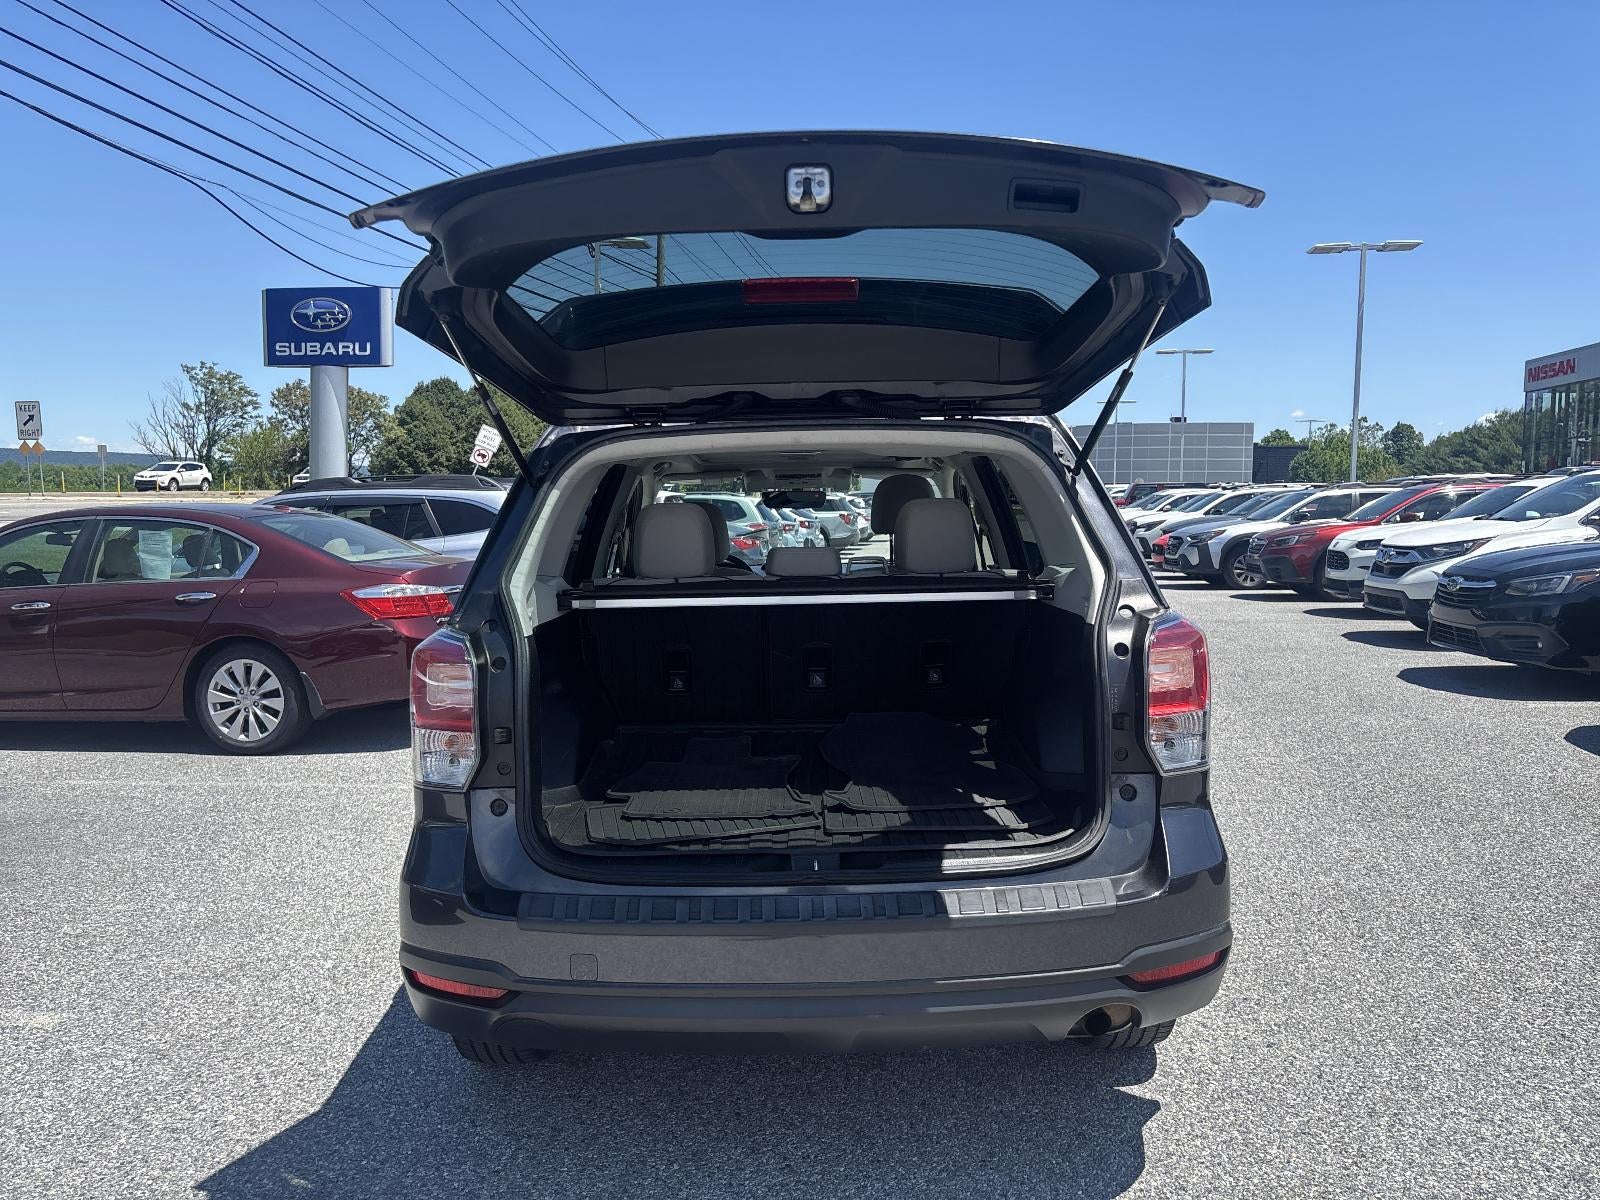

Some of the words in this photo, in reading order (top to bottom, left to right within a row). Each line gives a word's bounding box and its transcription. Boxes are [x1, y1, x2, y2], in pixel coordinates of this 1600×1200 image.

[275, 342, 371, 356] SUBARU
[1527, 357, 1576, 383] NISSAN
[19, 404, 36, 412] KEEP
[20, 429, 40, 437] RIGHT
